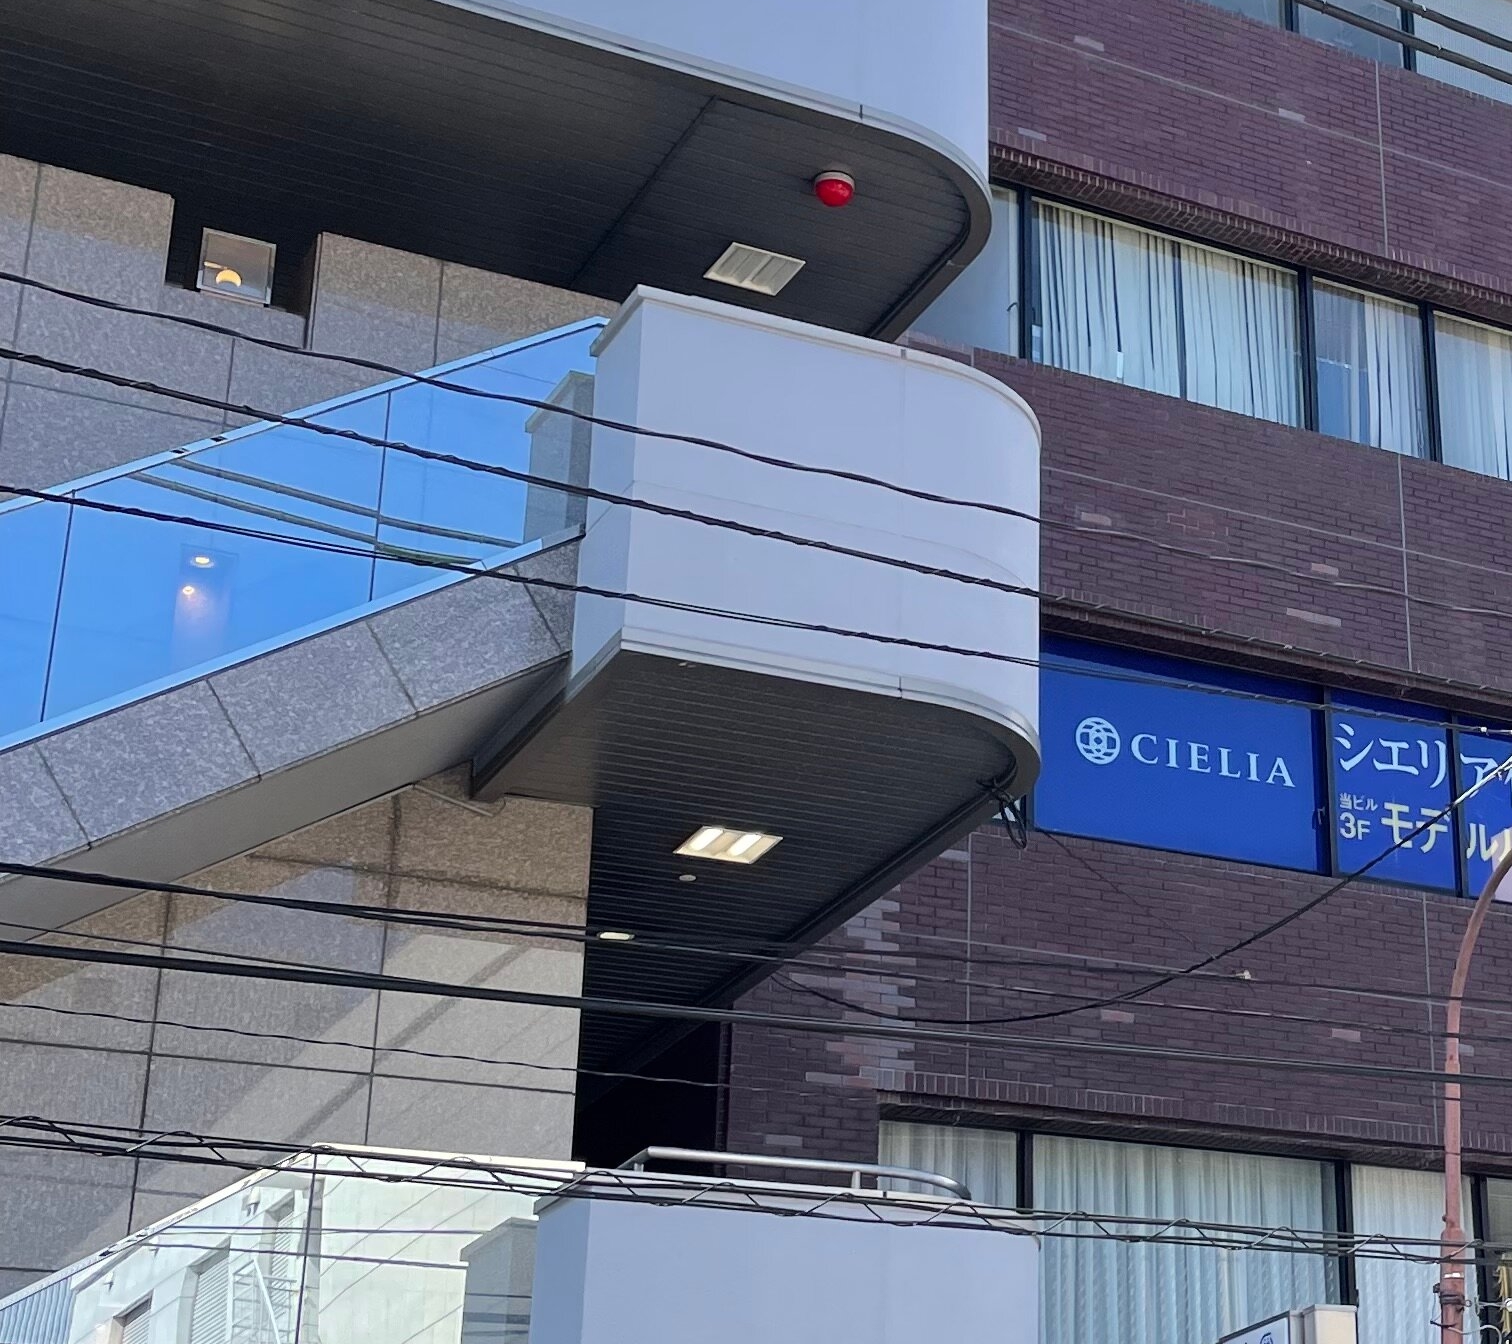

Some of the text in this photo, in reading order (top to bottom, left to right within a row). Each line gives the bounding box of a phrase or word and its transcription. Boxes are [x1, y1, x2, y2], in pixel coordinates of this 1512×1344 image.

[1130, 732, 1297, 787] CIELIA
[1339, 793, 1378, 812] 当ビル
[1339, 811, 1371, 841] 3F
